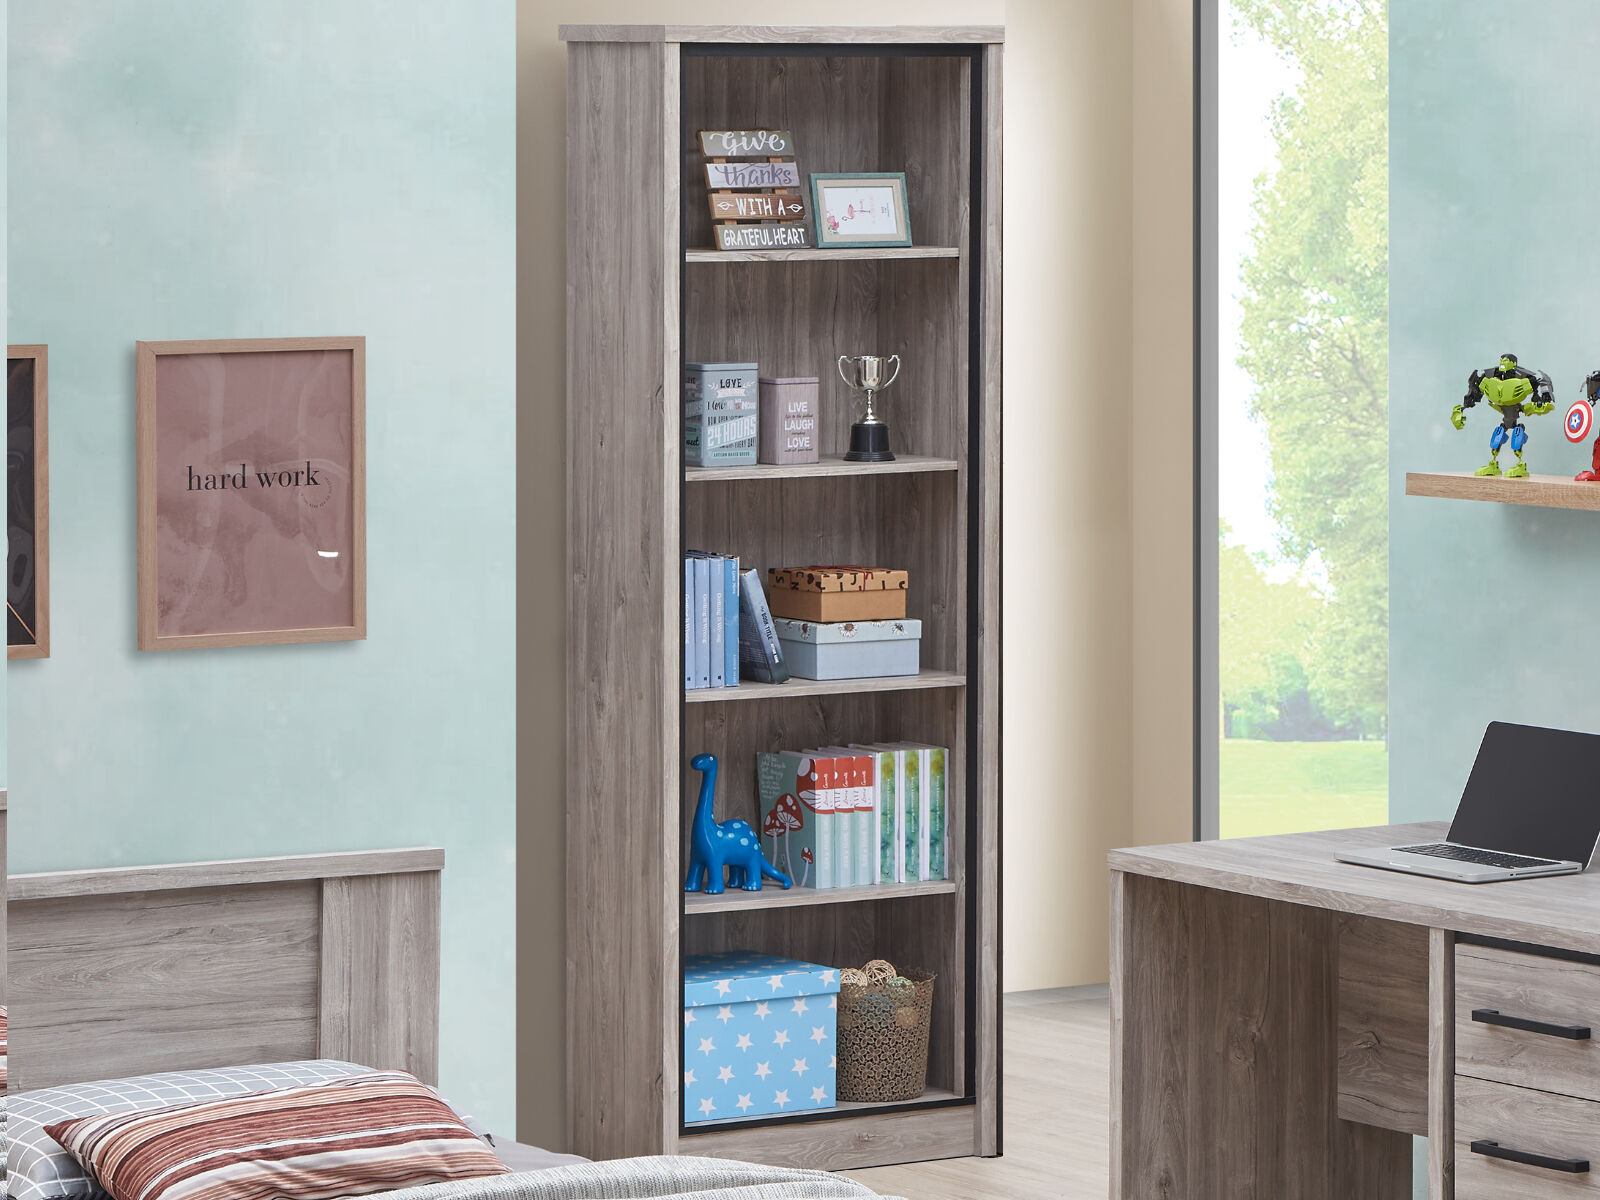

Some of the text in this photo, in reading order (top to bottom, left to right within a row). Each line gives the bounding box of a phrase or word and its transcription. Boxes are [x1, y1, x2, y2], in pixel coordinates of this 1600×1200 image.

[715, 163, 792, 186] thanks
[735, 198, 786, 216] WITH A
[724, 228, 805, 247] GRATEFUL HEART
[720, 378, 742, 389] LOVE
[788, 401, 808, 413] LIVE
[707, 417, 756, 447] 24 HOURS
[784, 419, 814, 431] LAUGH
[787, 436, 810, 448] LOVE
[186, 461, 320, 491] hard work
